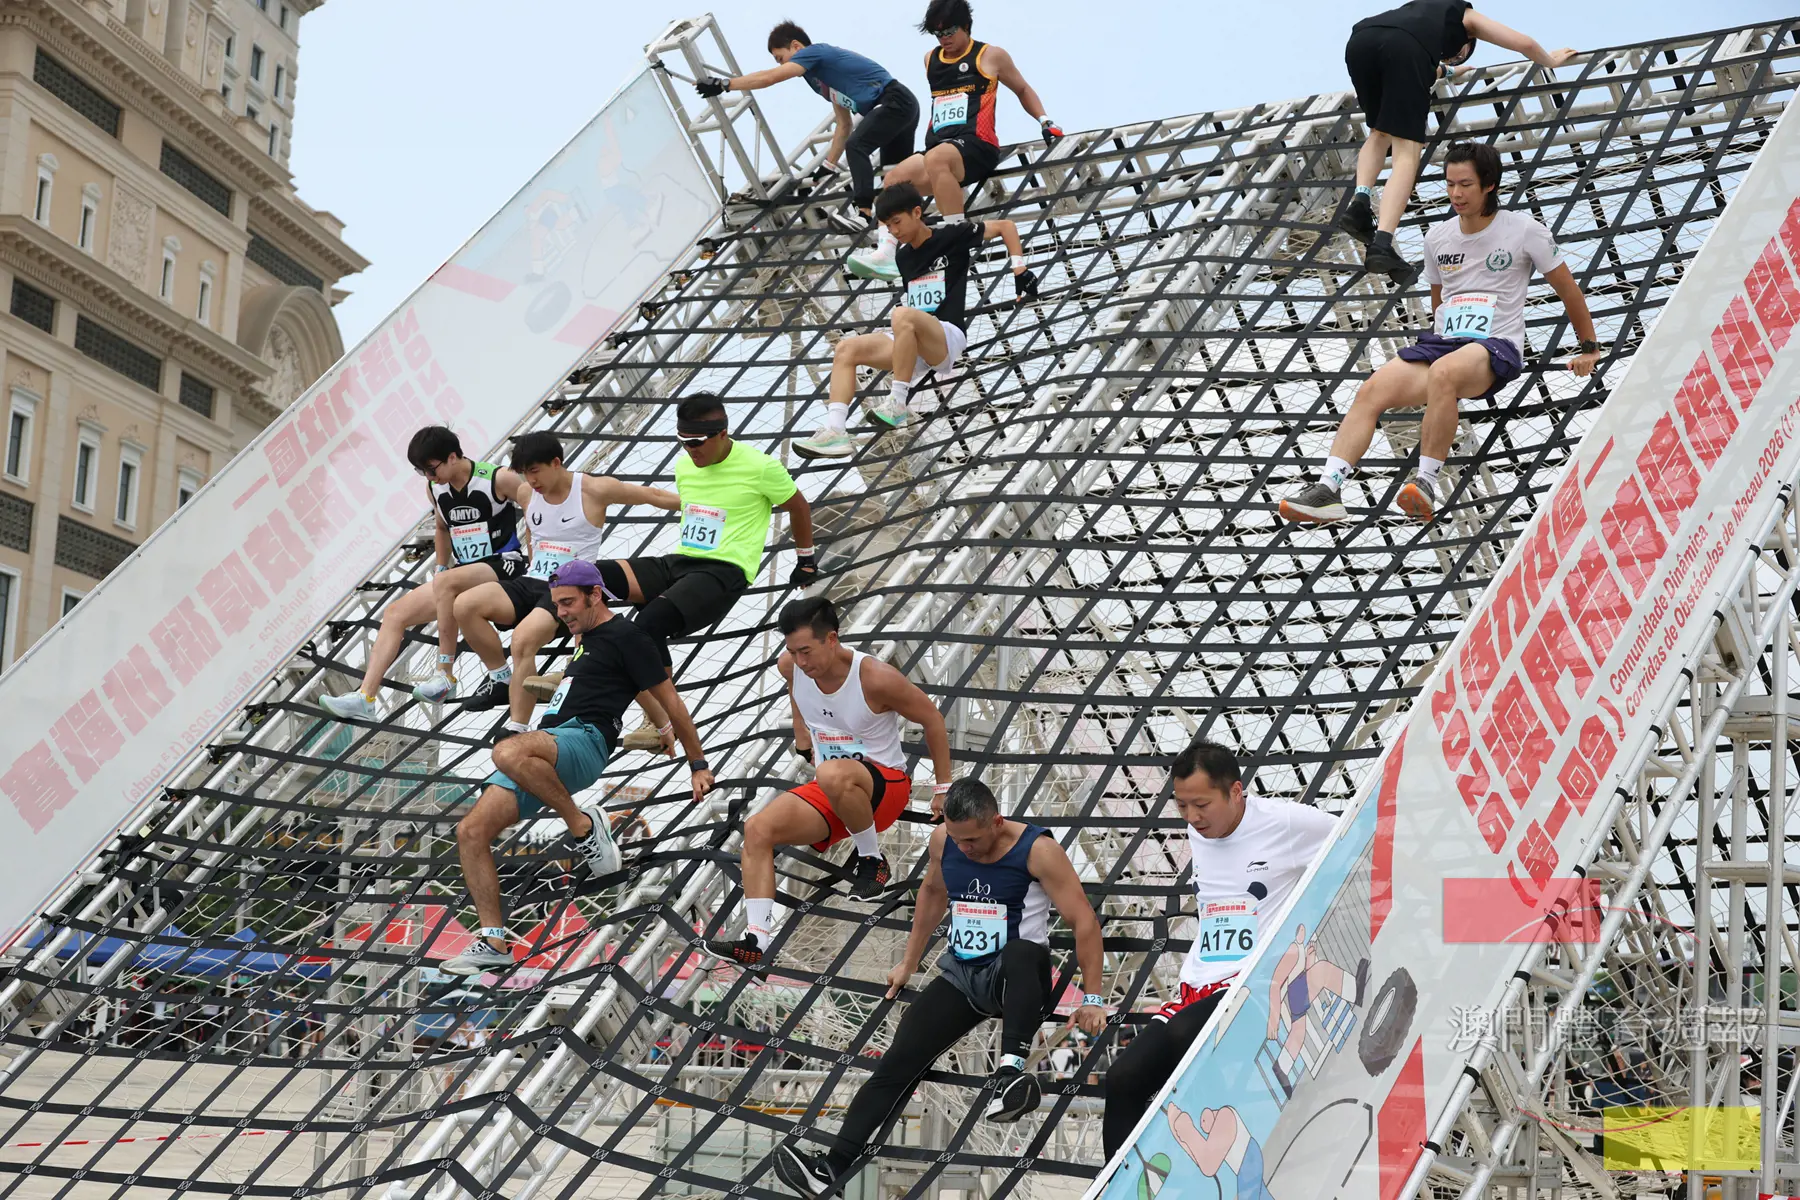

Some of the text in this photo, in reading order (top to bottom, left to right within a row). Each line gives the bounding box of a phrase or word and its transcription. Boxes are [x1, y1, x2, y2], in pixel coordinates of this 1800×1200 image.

[933, 106, 966, 126] A156
[909, 290, 943, 308] A103
[1444, 314, 1489, 334] A172
[1478, 196, 1800, 810] 澳門競技障礙挑戰
[682, 524, 717, 544] A151
[457, 542, 488, 560] A127
[1458, 434, 1615, 716] 活力社區一
[1625, 645, 1667, 718] Corridas
[1664, 625, 1679, 650] de
[1674, 541, 1724, 628] Obstáculos
[1723, 522, 1735, 546] de
[1731, 473, 1763, 522] Macau
[1758, 429, 1785, 478] 2026
[1609, 595, 1668, 695] Comunidade
[1663, 525, 1709, 599] Dinâmica
[1431, 664, 1515, 855] 2026
[953, 928, 1000, 951] A231
[1200, 928, 1254, 952] A176
